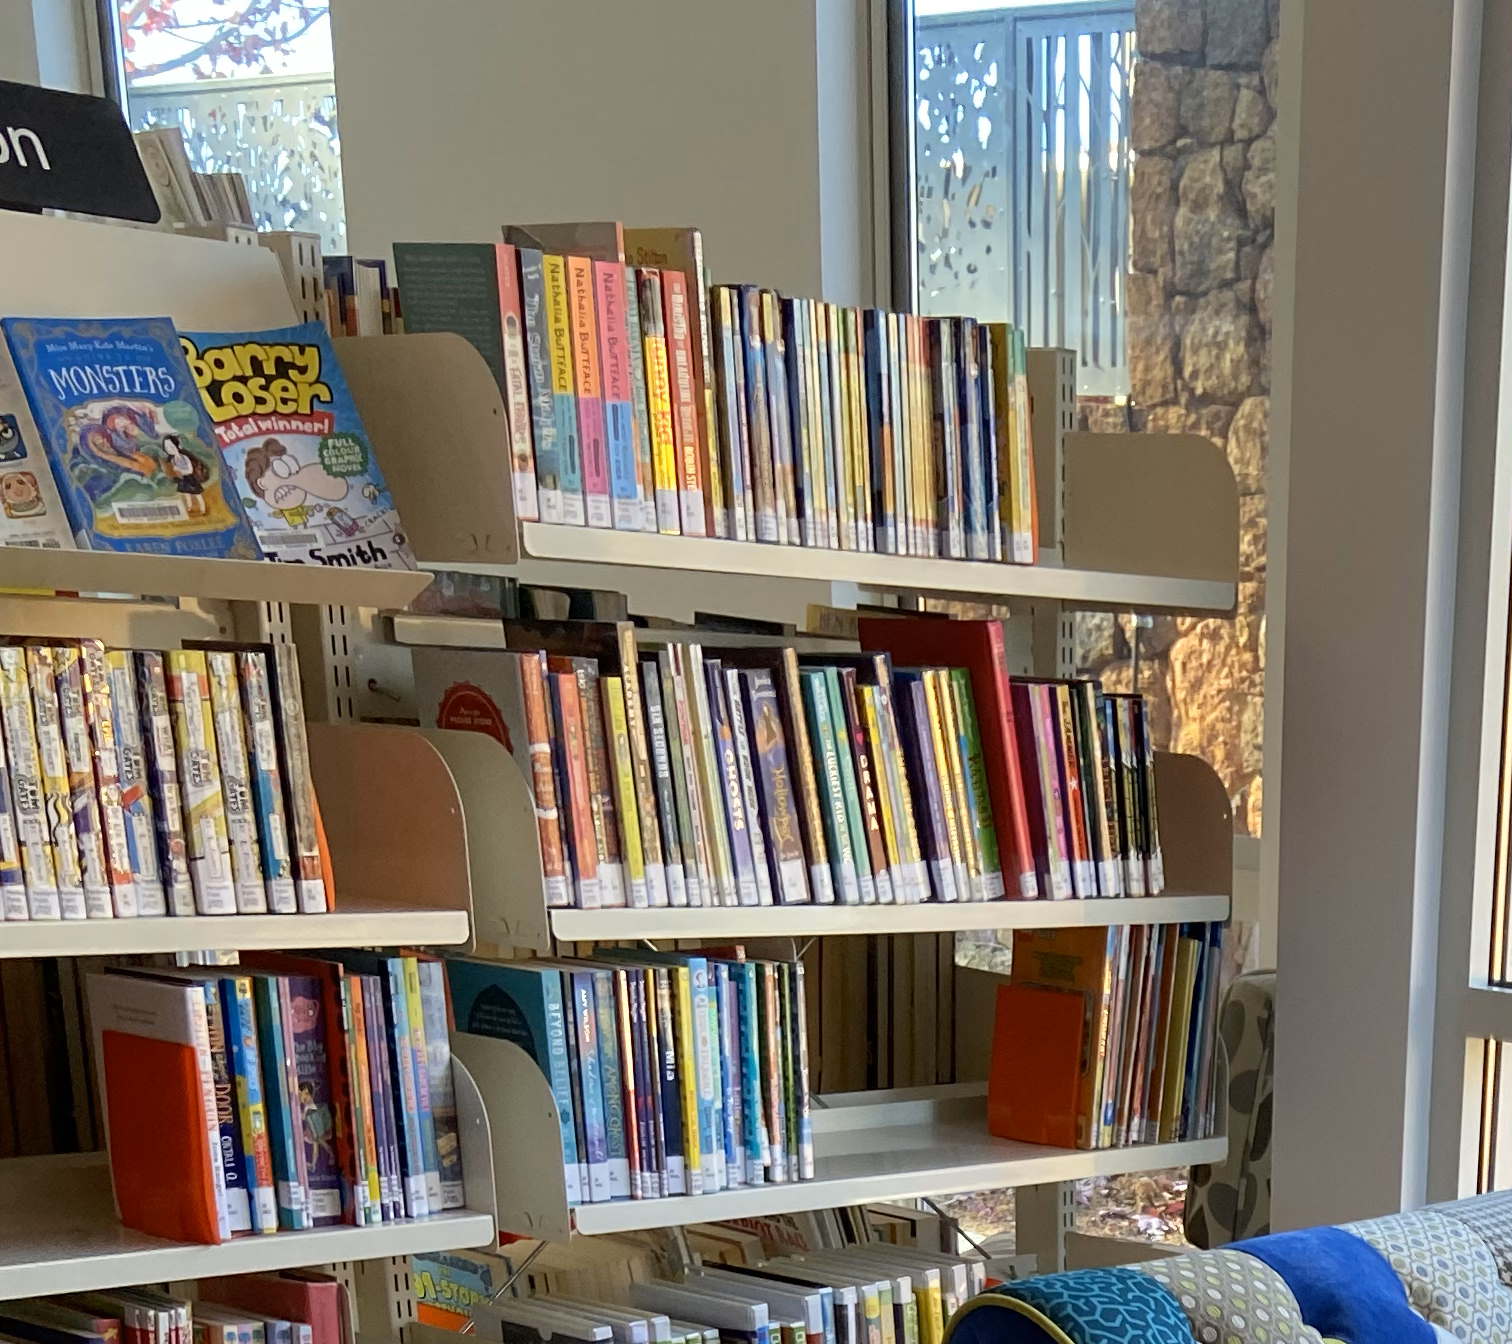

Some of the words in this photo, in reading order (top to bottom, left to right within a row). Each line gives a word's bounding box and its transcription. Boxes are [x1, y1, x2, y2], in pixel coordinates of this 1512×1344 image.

[0, 126, 51, 170] n
[549, 264, 563, 324] Nathalia
[574, 267, 588, 331] Nathalia
[603, 272, 616, 332] Nathalia
[48, 364, 176, 401] MONSTERS
[179, 337, 320, 388] Barry
[199, 376, 332, 422] Loser
[214, 417, 258, 441] Total
[258, 415, 329, 436] winner!
[327, 438, 355, 447] FULL
[123, 748, 135, 782] GATES
[133, 750, 144, 780] TOM
[190, 751, 202, 785] GATES
[200, 751, 212, 784] TOM
[826, 751, 843, 798] LUCKIEST
[17, 777, 30, 812] GATES
[28, 779, 41, 811] TOM
[228, 778, 241, 813] GATES
[238, 783, 250, 810] TOM
[724, 749, 745, 831] GHOSTS
[859, 754, 879, 831] DRAMA
[833, 799, 844, 824] KID
[547, 1003, 565, 1056] BEYOND
[552, 1058, 570, 1105] BELIEF
[665, 1050, 676, 1081] Mia
[214, 1083, 235, 1126] DOOR
[603, 1064, 621, 1113] AMONG
